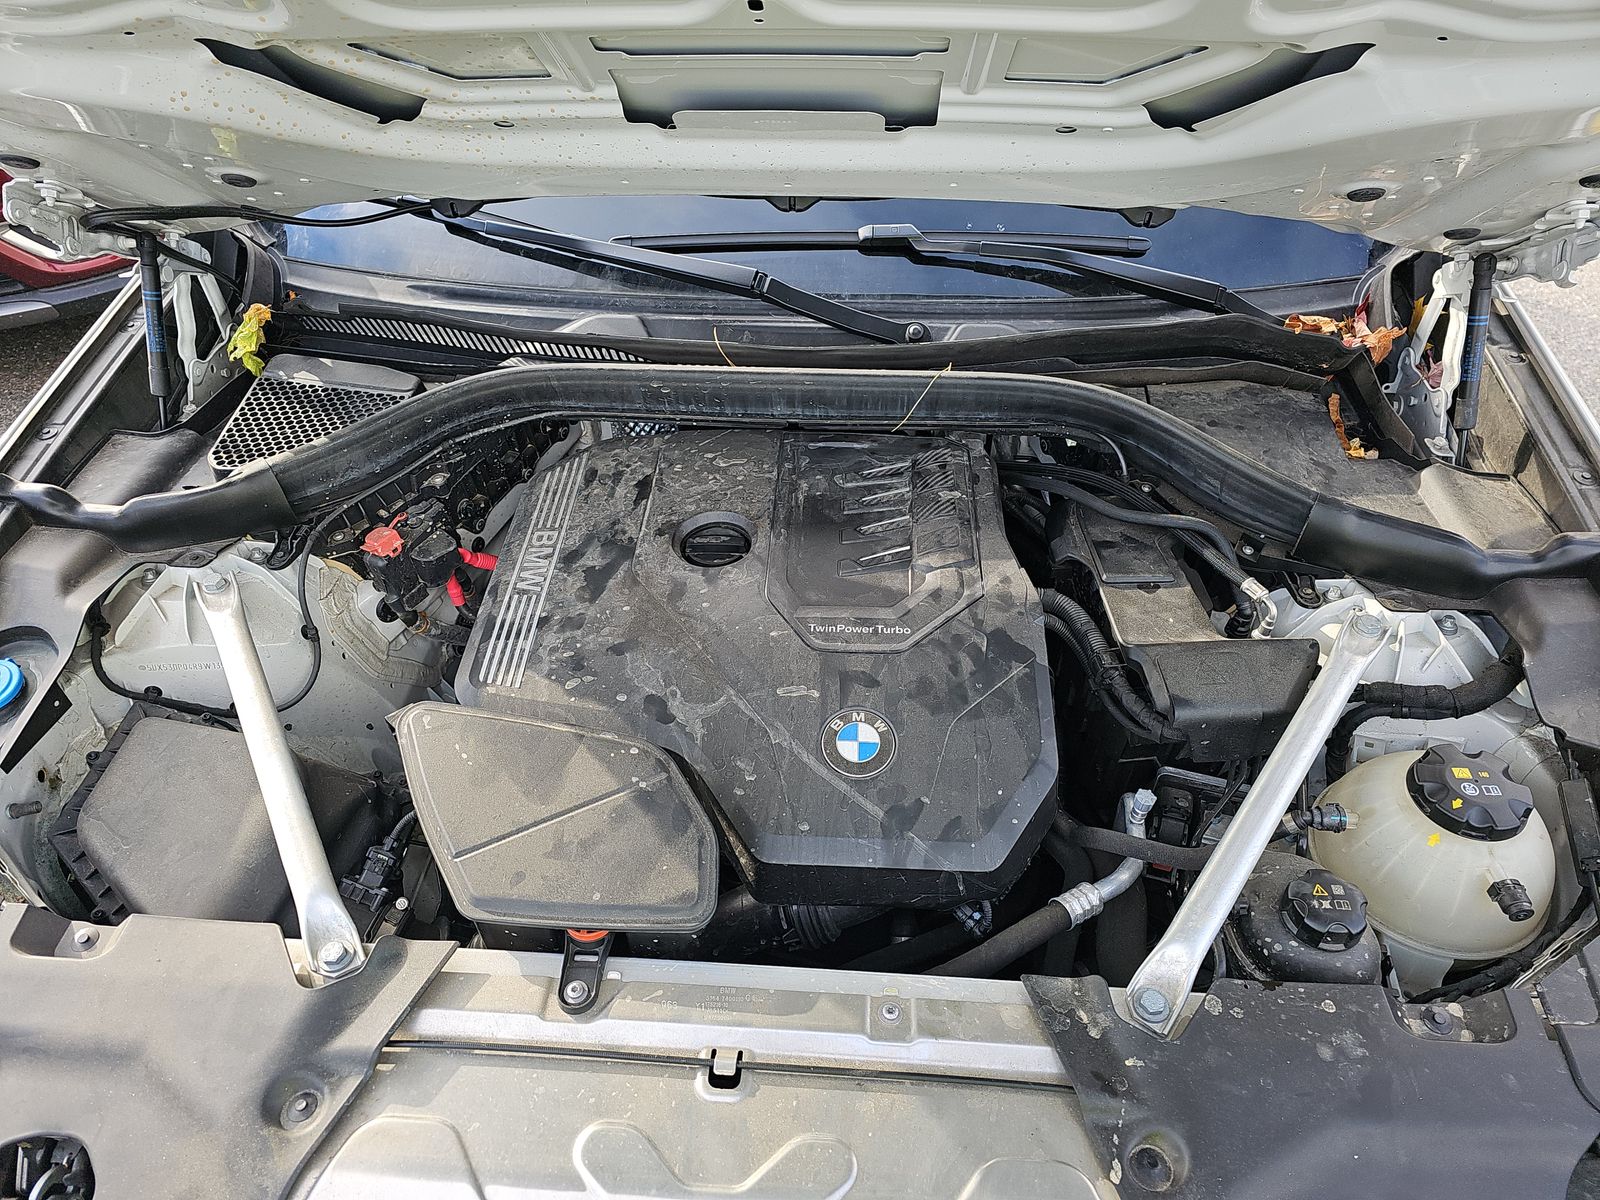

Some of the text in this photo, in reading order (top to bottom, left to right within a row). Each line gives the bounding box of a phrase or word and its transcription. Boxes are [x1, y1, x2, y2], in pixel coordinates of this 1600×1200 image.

[515, 530, 559, 592] BMW
[807, 623, 912, 635] TwinPower Turbo
[829, 712, 888, 733] BMW
